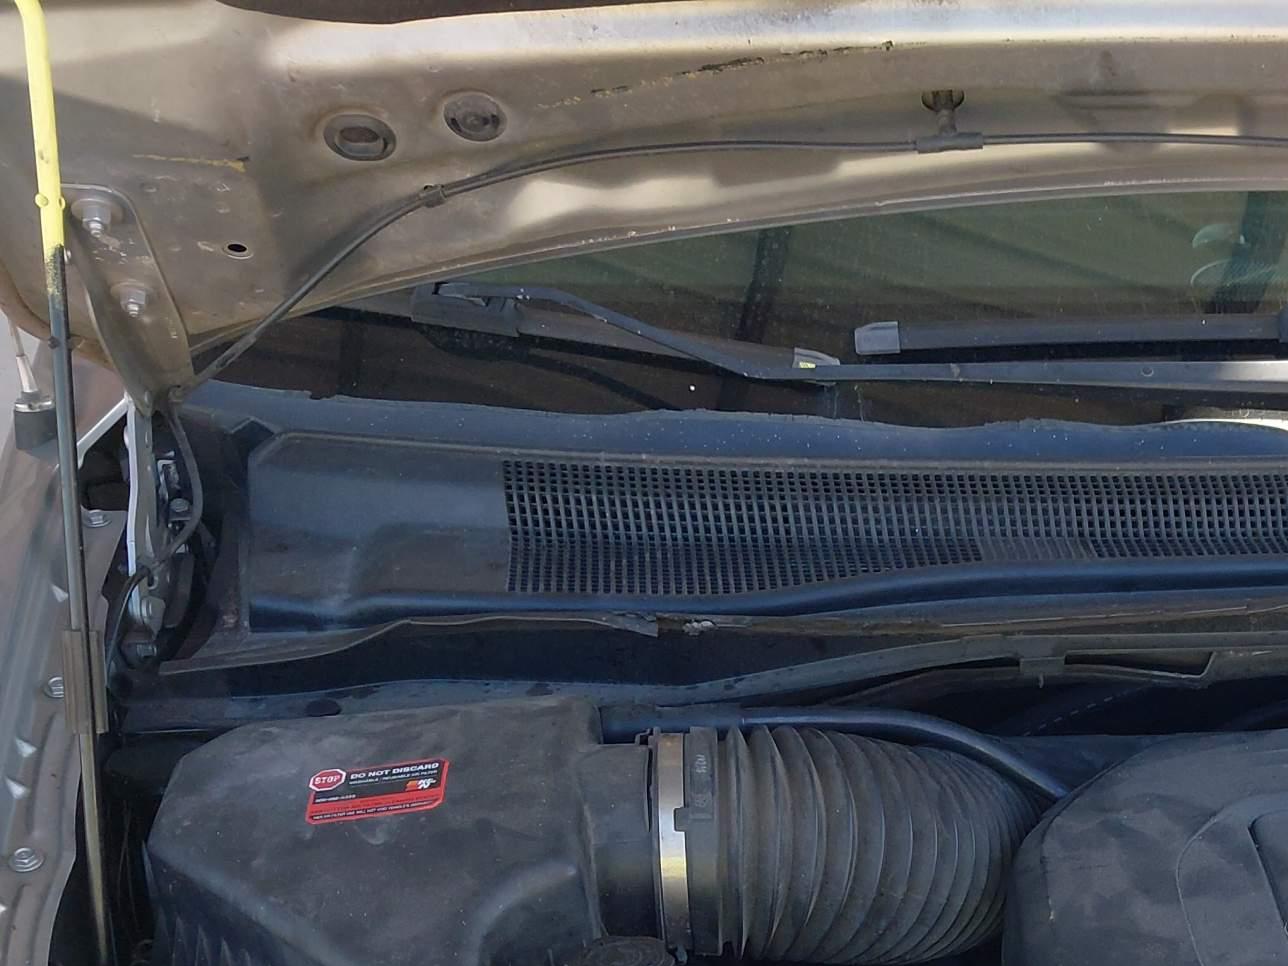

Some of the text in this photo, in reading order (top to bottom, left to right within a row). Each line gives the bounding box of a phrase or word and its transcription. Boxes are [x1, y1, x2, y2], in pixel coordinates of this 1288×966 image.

[350, 762, 439, 780] DO NOT DISCARD
[314, 774, 341, 785] STOP
